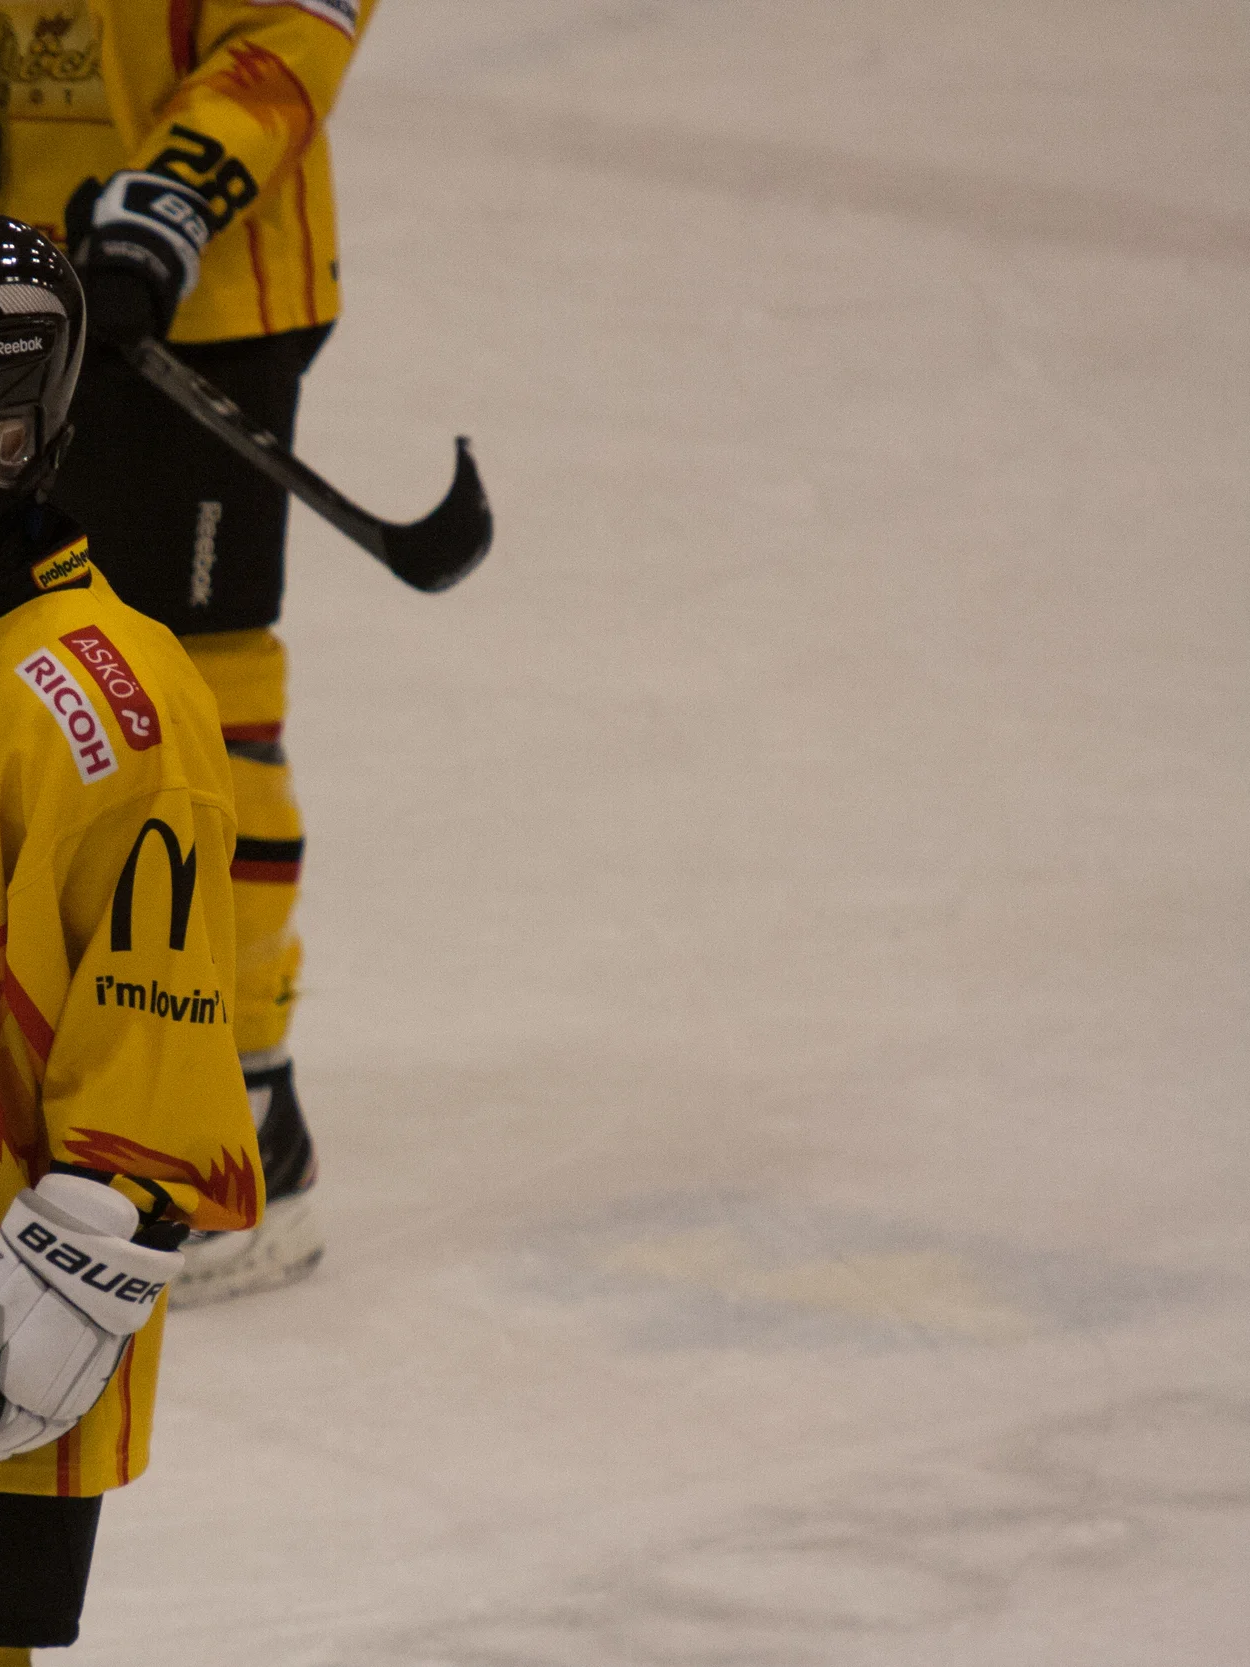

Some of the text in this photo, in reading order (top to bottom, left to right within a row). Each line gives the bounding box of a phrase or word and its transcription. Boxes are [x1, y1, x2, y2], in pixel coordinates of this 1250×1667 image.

[71, 638, 140, 698] ASKÖ
[24, 655, 112, 775] RICOH
[95, 975, 146, 1011] i'm
